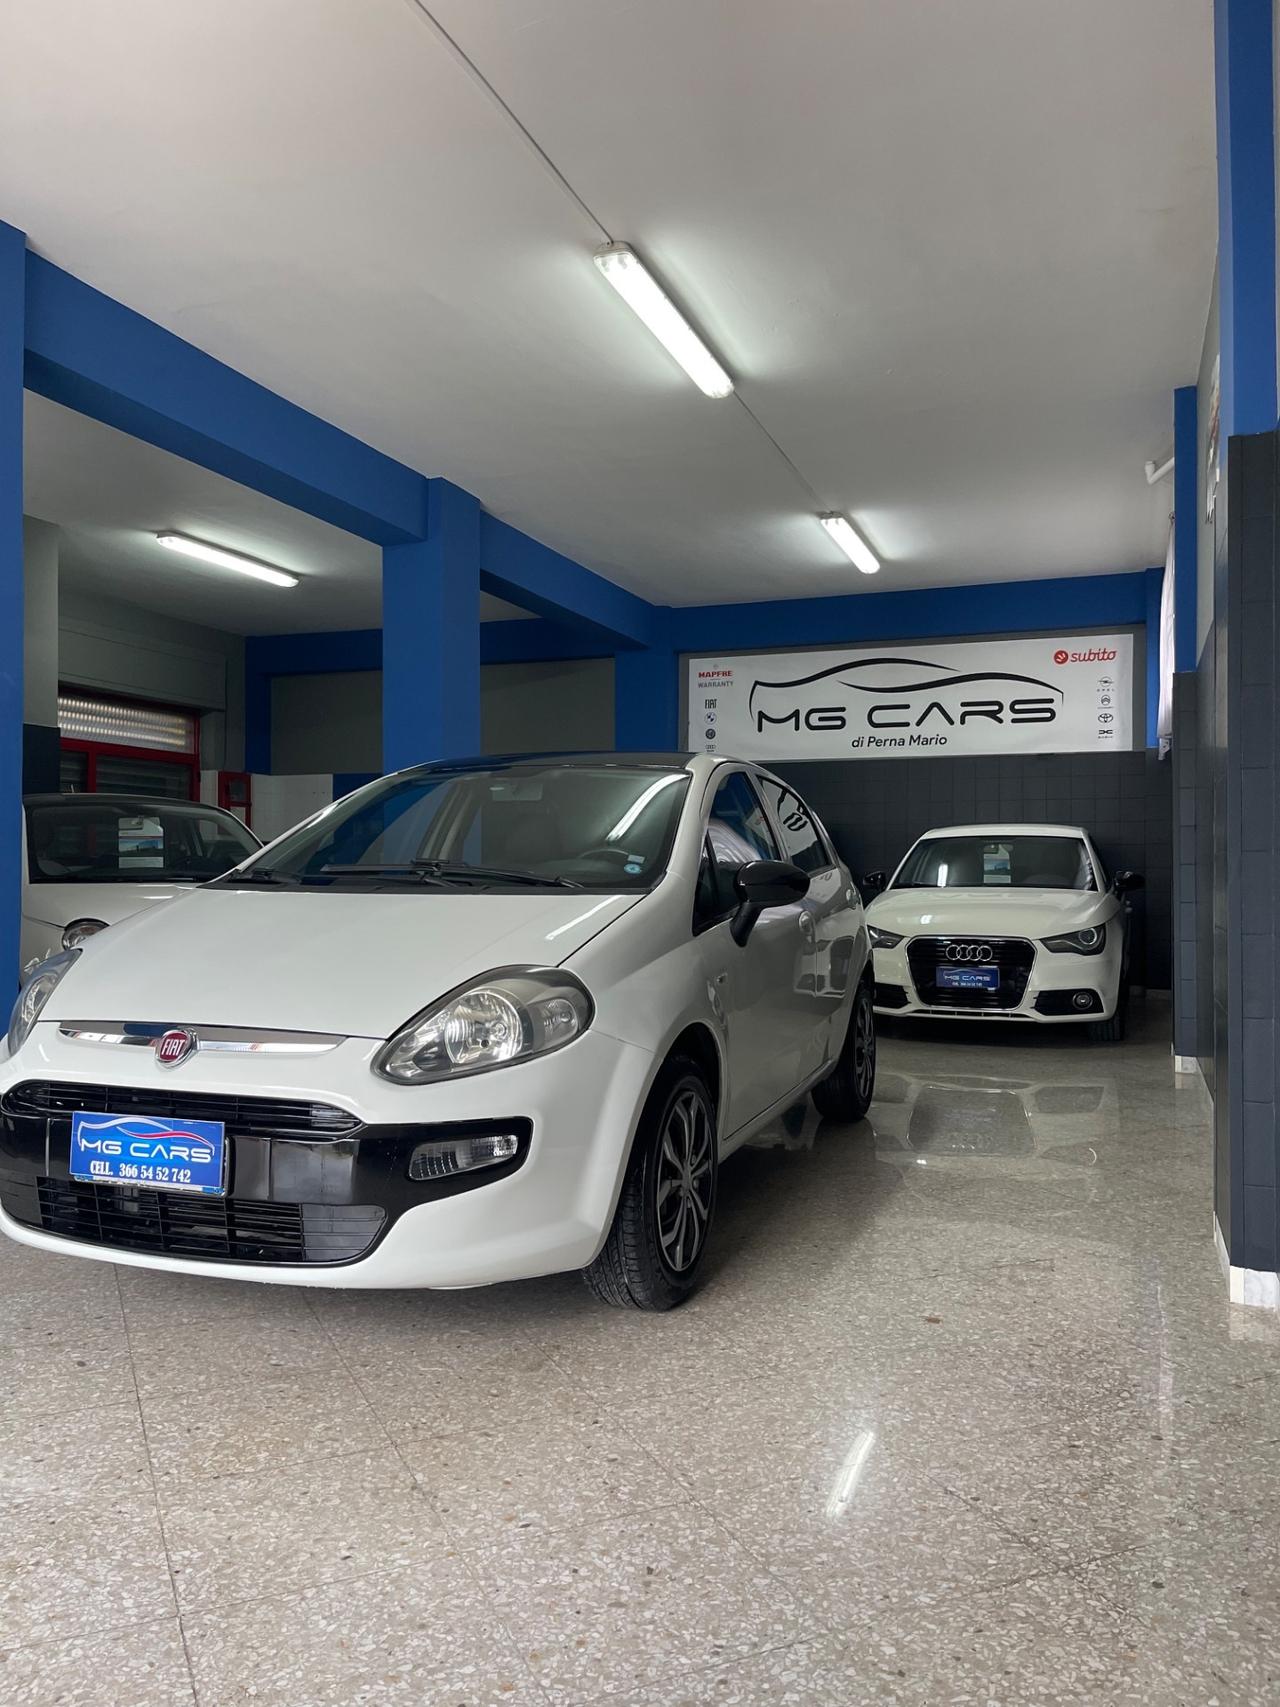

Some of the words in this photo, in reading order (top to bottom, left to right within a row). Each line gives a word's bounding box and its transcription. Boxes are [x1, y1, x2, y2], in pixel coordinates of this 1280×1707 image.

[1070, 648, 1117, 663] subito
[698, 670, 733, 678] MAPFRE
[698, 681, 733, 689] WARRANTY
[704, 699, 717, 709] FIAT
[757, 706, 846, 733] MG
[867, 698, 1056, 728] CARS
[851, 736, 864, 748] di
[867, 735, 905, 747] Perna
[908, 734, 948, 746] Mario
[161, 1039, 185, 1056] FIAT
[80, 1138, 122, 1154] MG
[129, 1143, 211, 1163] CARS
[90, 1160, 113, 1176] CELL.
[119, 1163, 138, 1178] 366
[140, 1166, 154, 1179] 54
[156, 1167, 169, 1181] 52
[171, 1168, 191, 1183] 742
